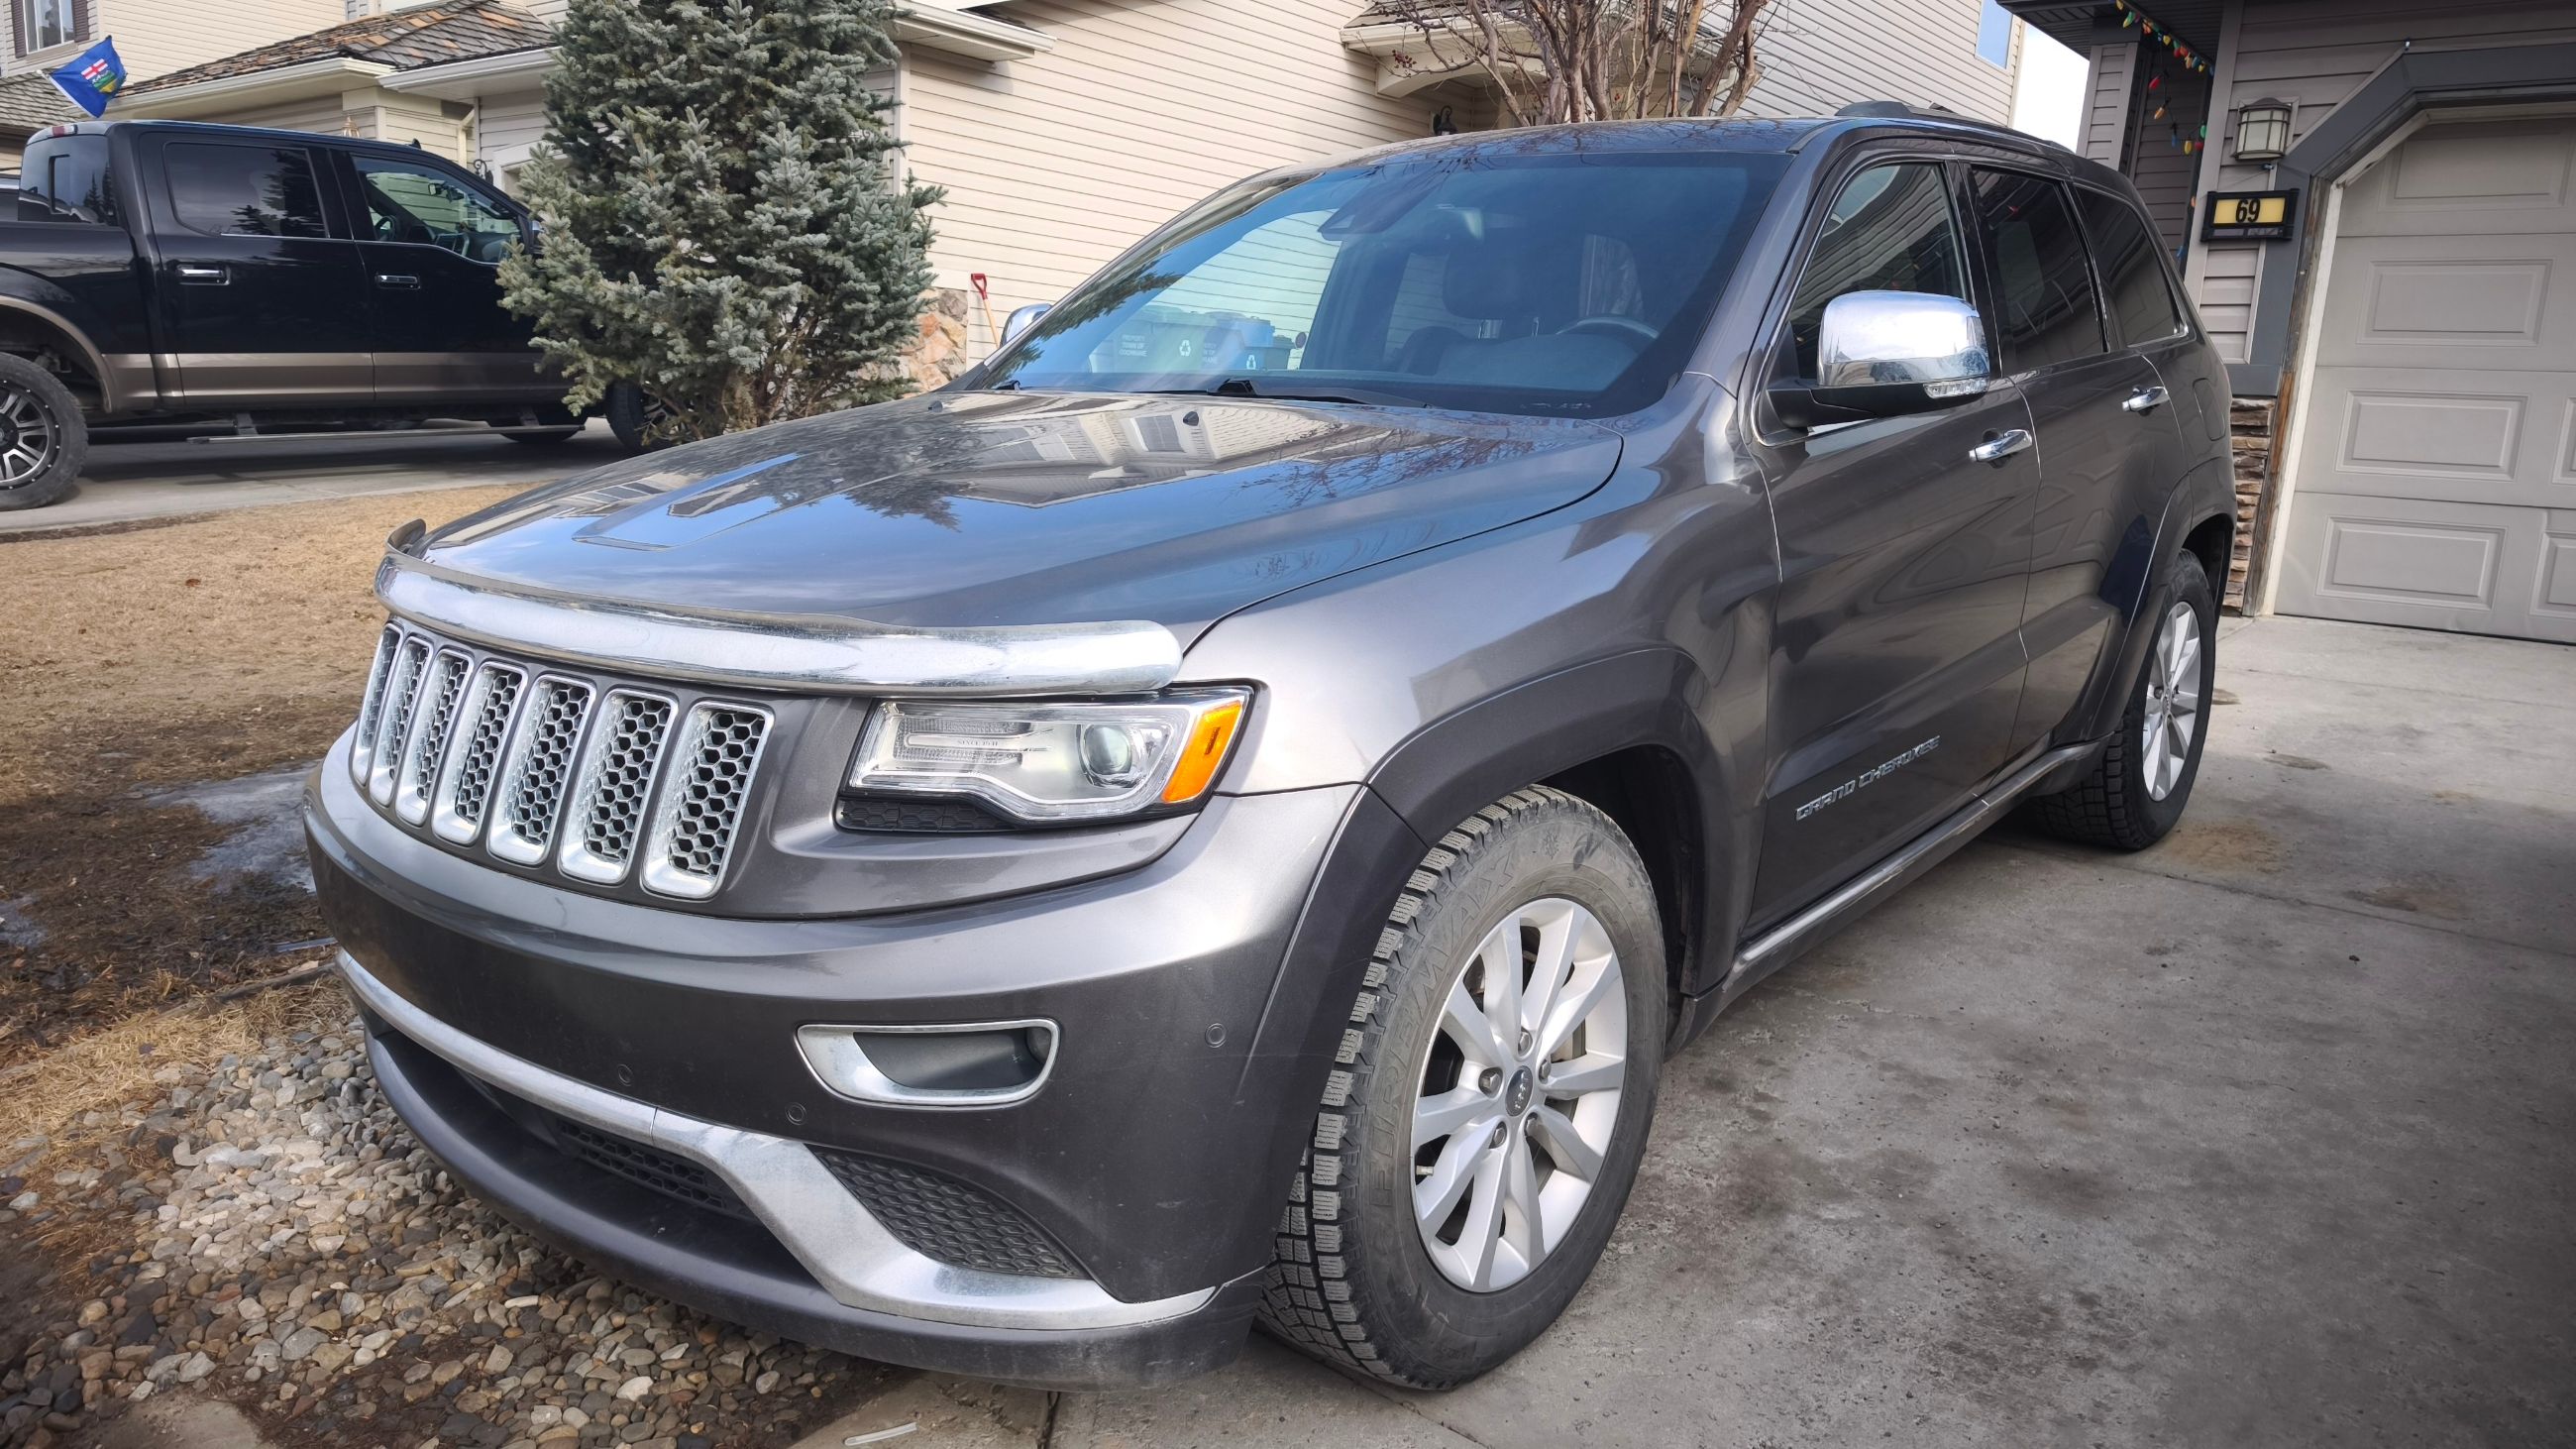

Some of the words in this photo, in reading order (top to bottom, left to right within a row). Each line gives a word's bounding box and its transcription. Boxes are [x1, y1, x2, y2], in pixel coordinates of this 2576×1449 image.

[2235, 198, 2261, 223] 69
[1795, 779, 1856, 821] GRAND
[1859, 735, 1940, 788] CHEROKEE
